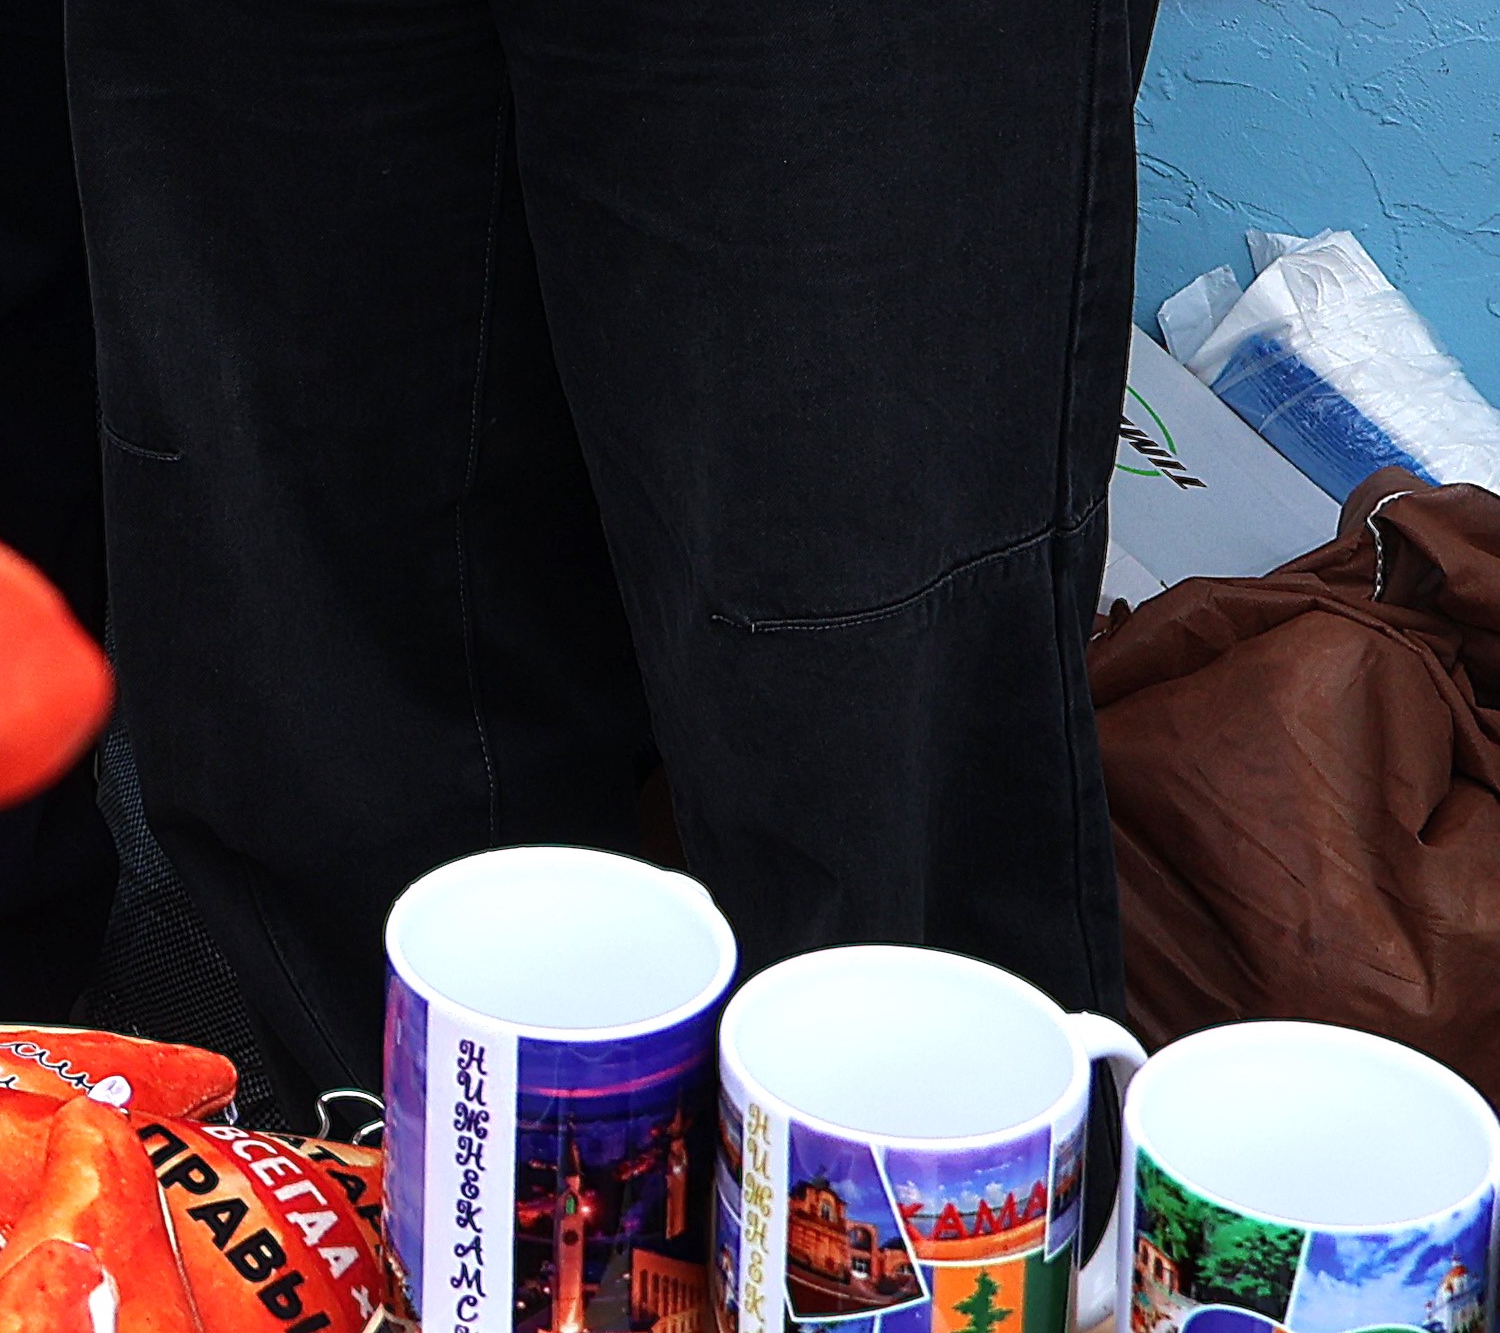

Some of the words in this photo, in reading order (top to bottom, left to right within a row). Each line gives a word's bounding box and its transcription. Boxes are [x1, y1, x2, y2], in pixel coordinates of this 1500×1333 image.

[136, 1123, 331, 1333] ПРАВЫ
[201, 1125, 359, 1280] ВСЕГДА
[744, 1103, 774, 1333] НИЖНЕК
